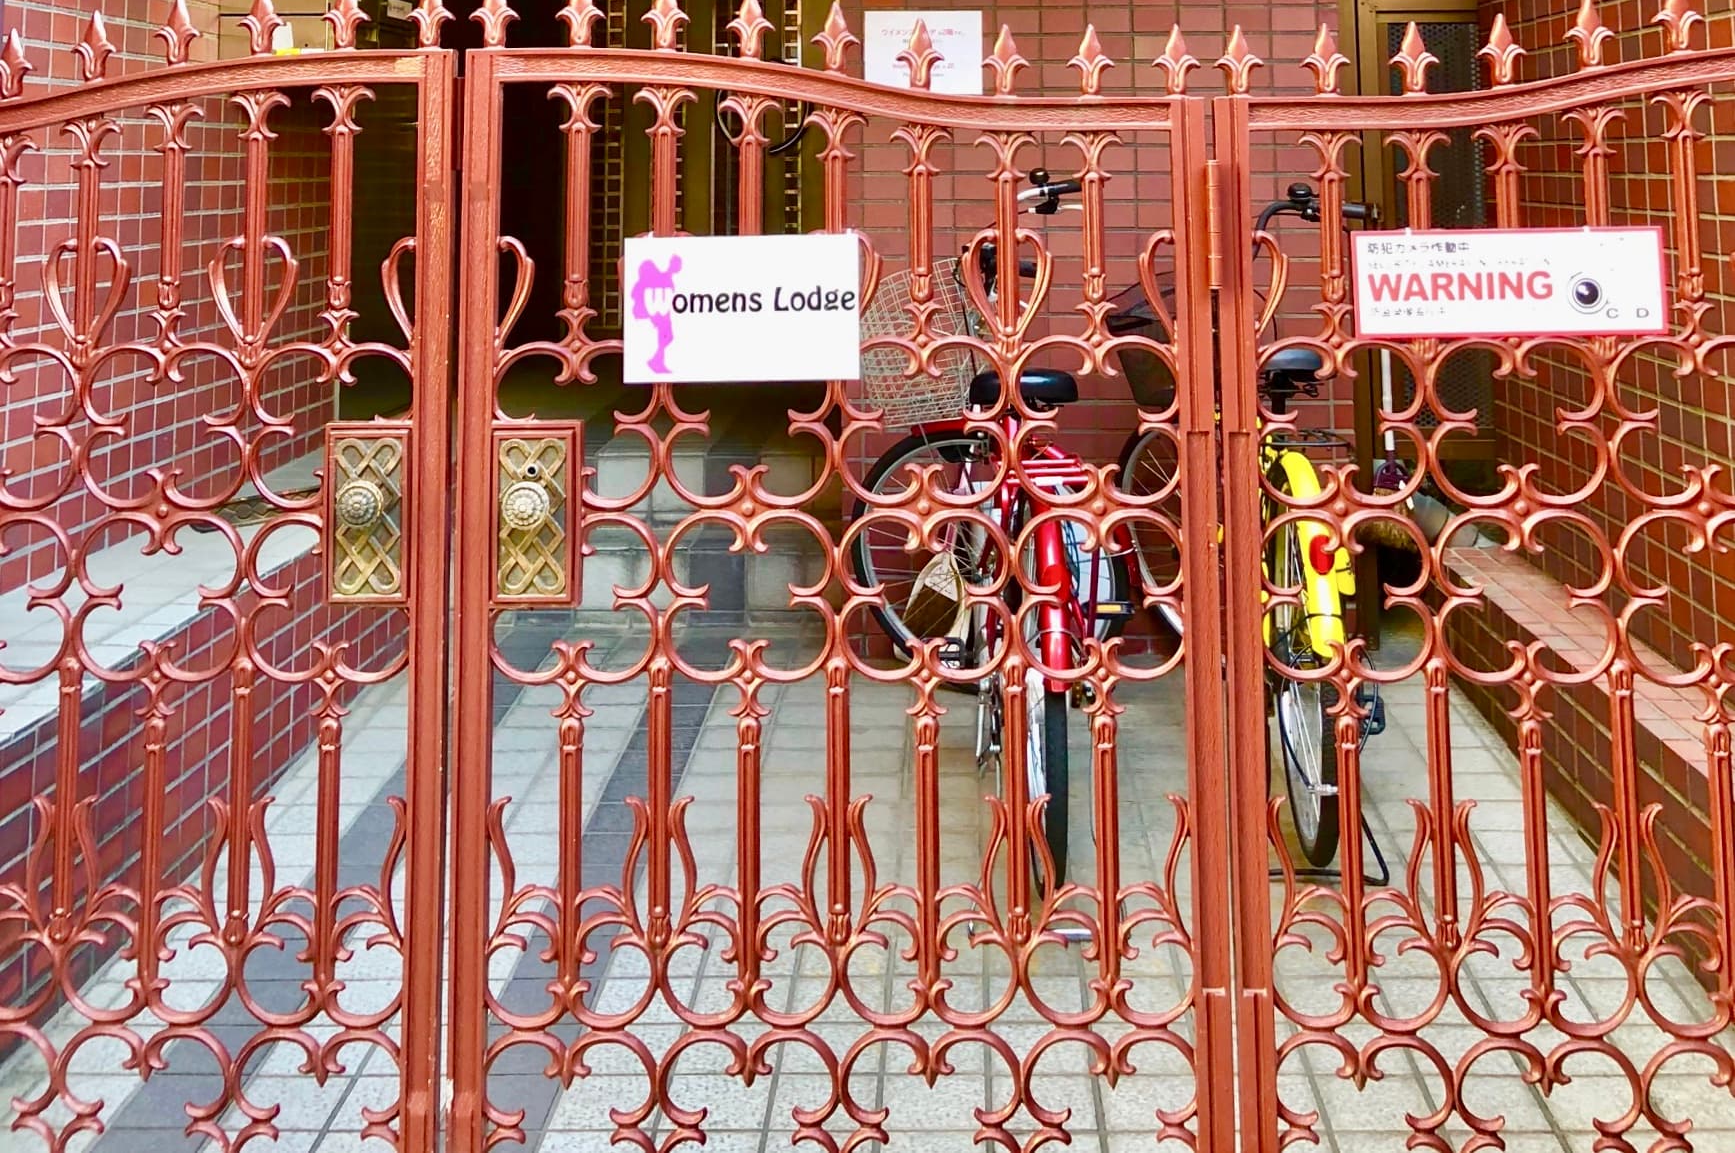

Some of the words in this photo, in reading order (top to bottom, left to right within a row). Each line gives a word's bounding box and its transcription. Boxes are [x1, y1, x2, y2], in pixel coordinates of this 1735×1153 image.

[643, 287, 763, 317] Womens
[773, 285, 857, 312] Lodge
[1367, 270, 1553, 302] WARNING
